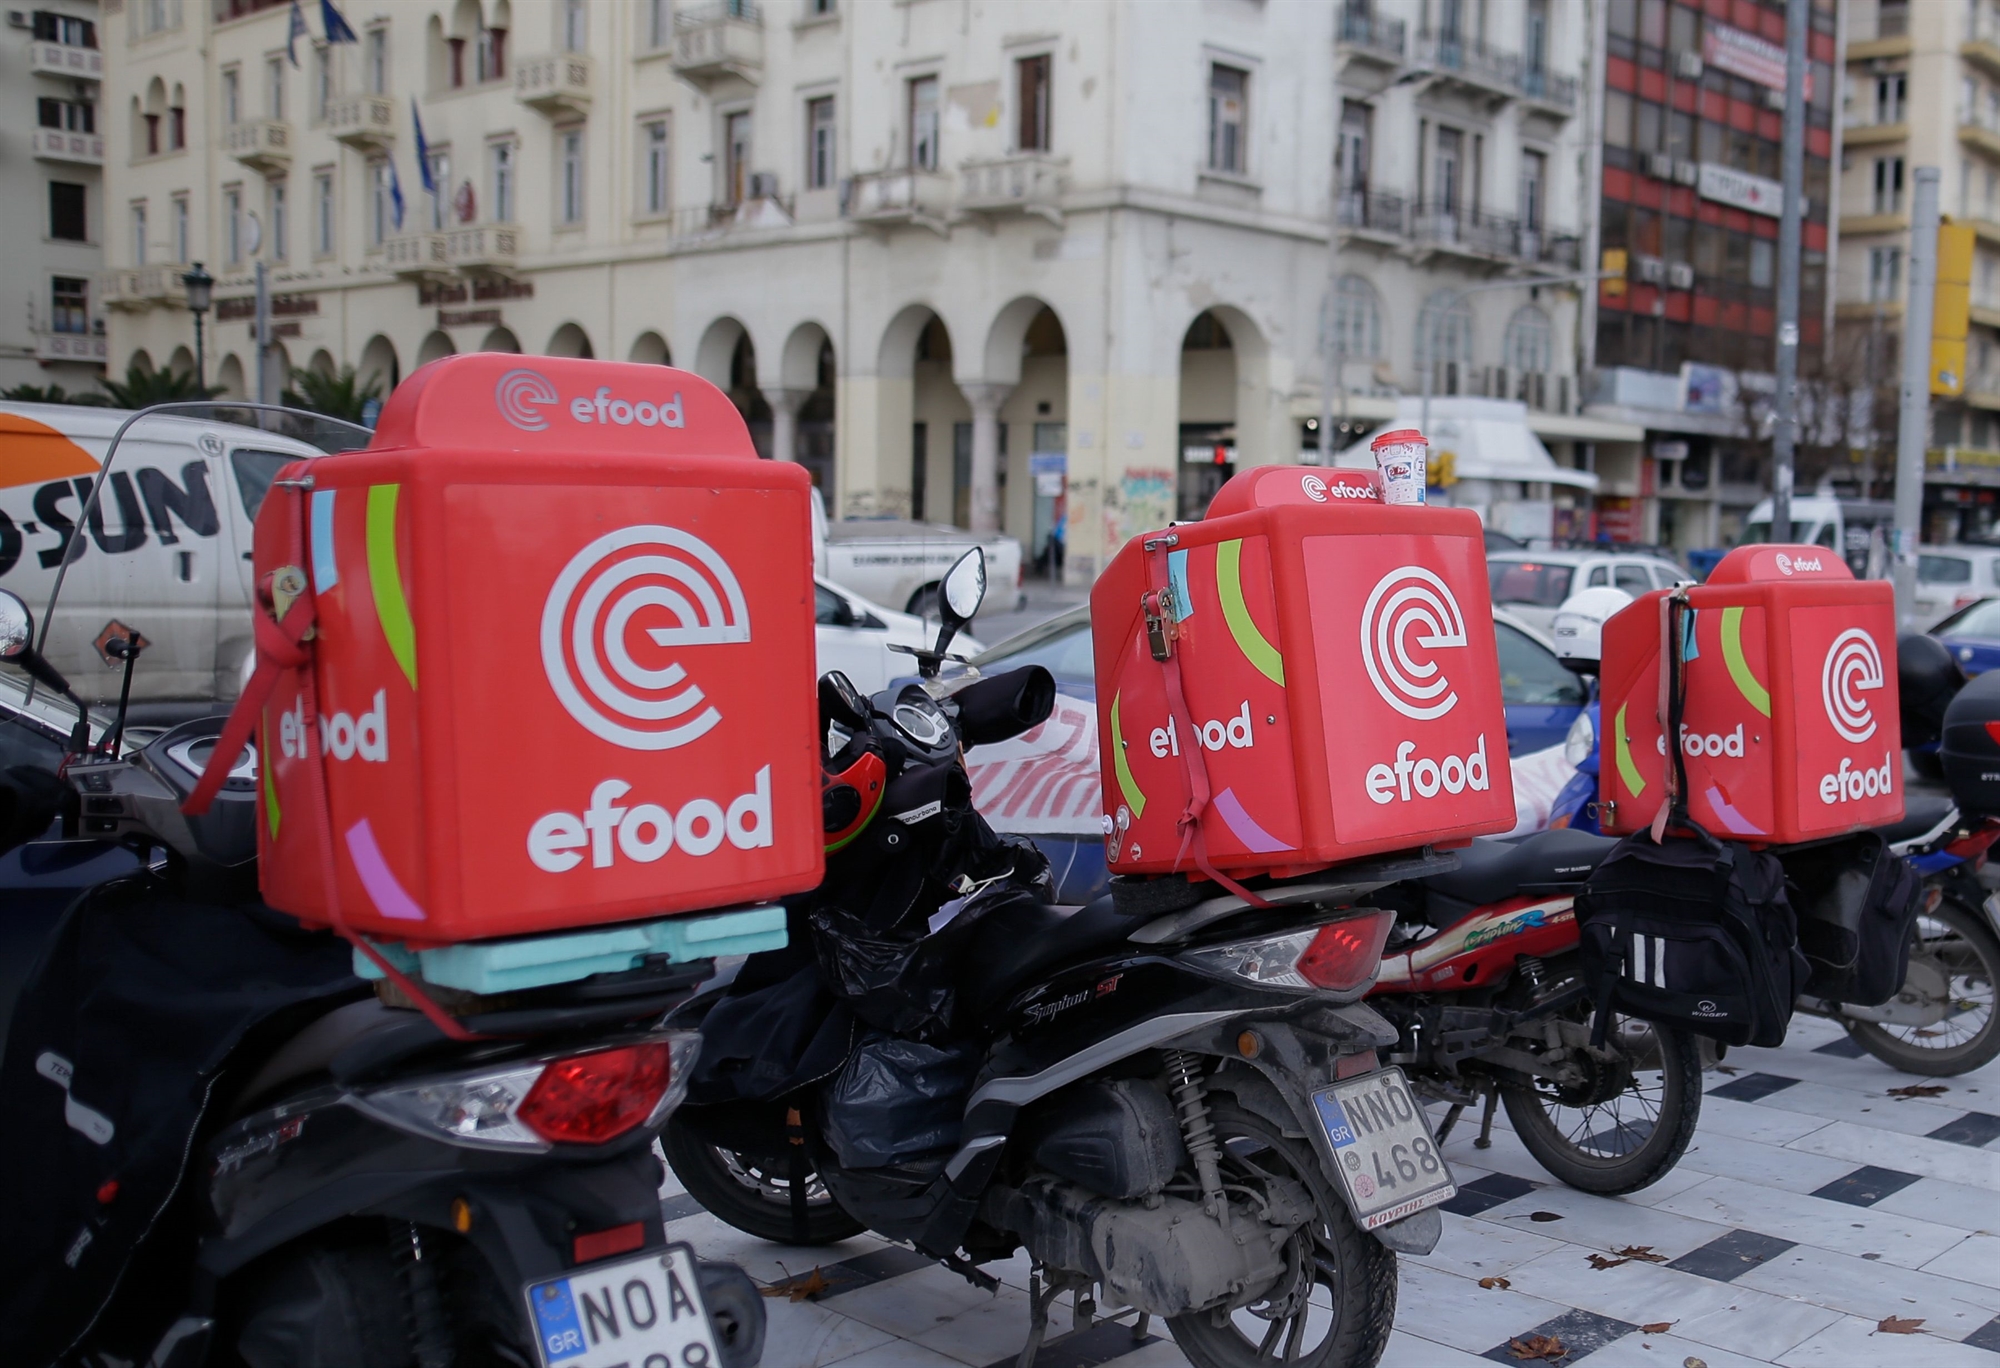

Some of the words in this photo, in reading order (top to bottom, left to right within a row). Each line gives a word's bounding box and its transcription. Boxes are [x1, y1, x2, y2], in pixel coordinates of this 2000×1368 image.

[570, 386, 685, 428] efood
[1331, 480, 1378, 500] efood
[1793, 557, 1823, 572] efood
[1365, 732, 1490, 805] efood
[1819, 751, 1892, 805] efood
[526, 763, 774, 873] efood
[1330, 1126, 1351, 1142] GR
[1342, 1085, 1413, 1138] NNO
[1372, 1137, 1439, 1189] 468
[579, 1269, 697, 1346] NOA
[547, 1329, 581, 1354] GR
